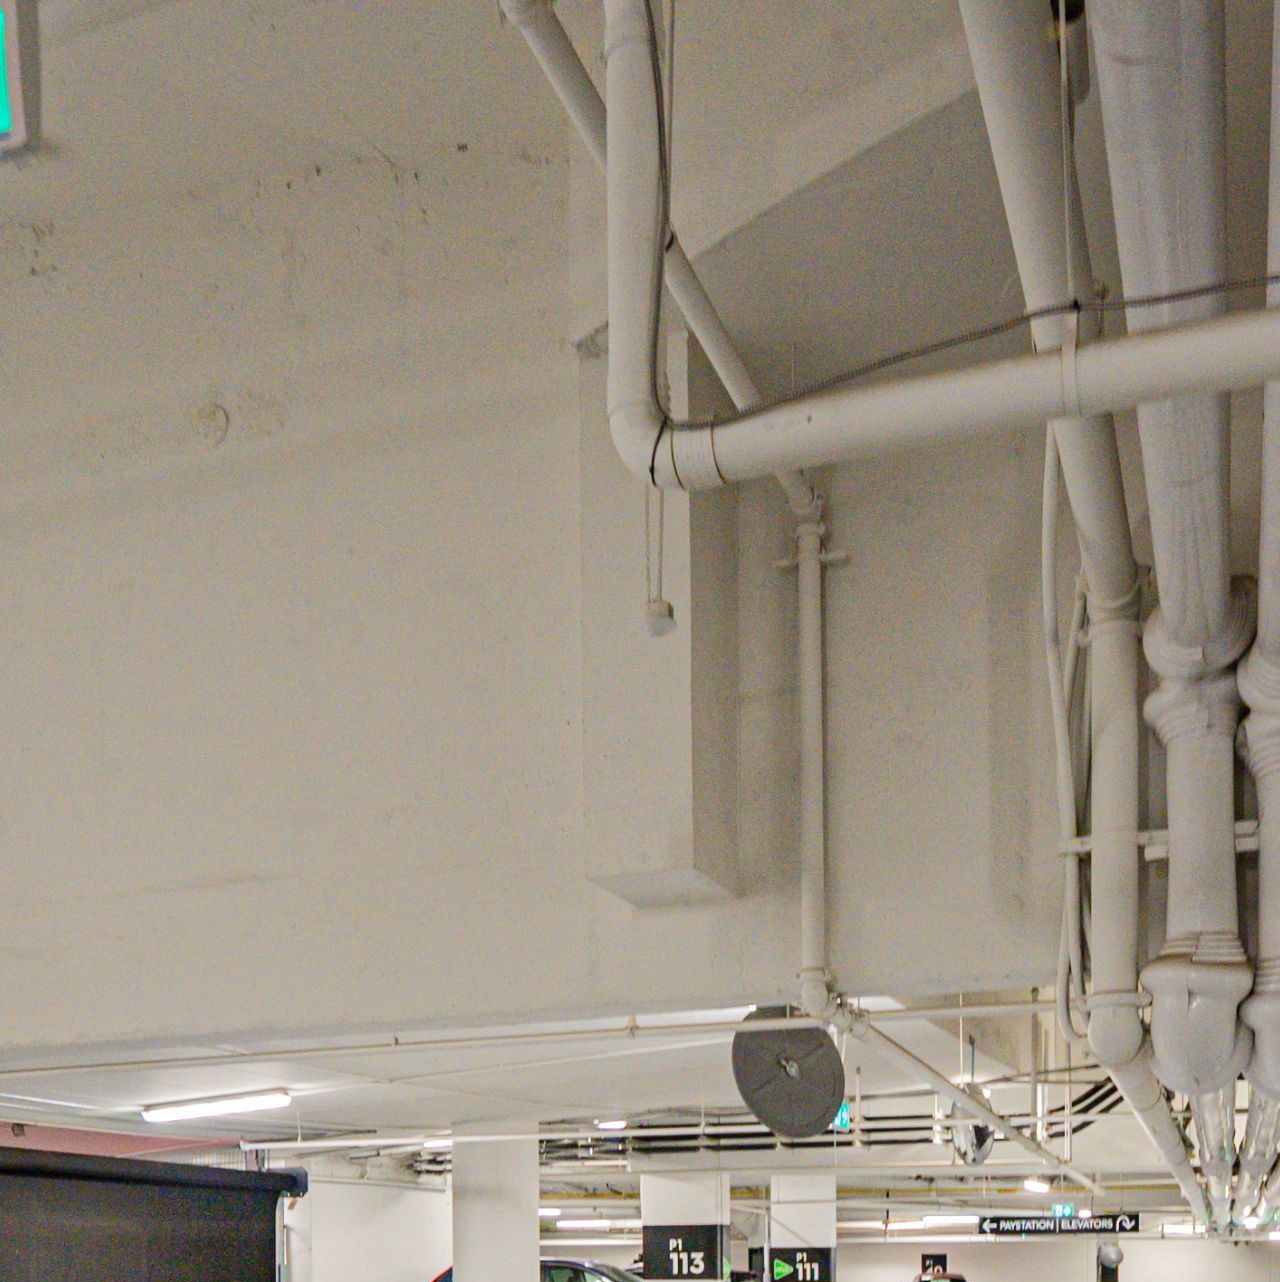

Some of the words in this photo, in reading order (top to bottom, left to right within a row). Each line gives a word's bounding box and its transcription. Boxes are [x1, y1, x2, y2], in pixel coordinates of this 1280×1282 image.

[999, 1219, 1054, 1231] PAYSTATION
[1061, 1218, 1113, 1232] ELEVATORS
[669, 1238, 683, 1251] P1
[669, 1251, 705, 1275] 113
[796, 1252, 807, 1262] P1
[795, 1262, 819, 1281] 111
